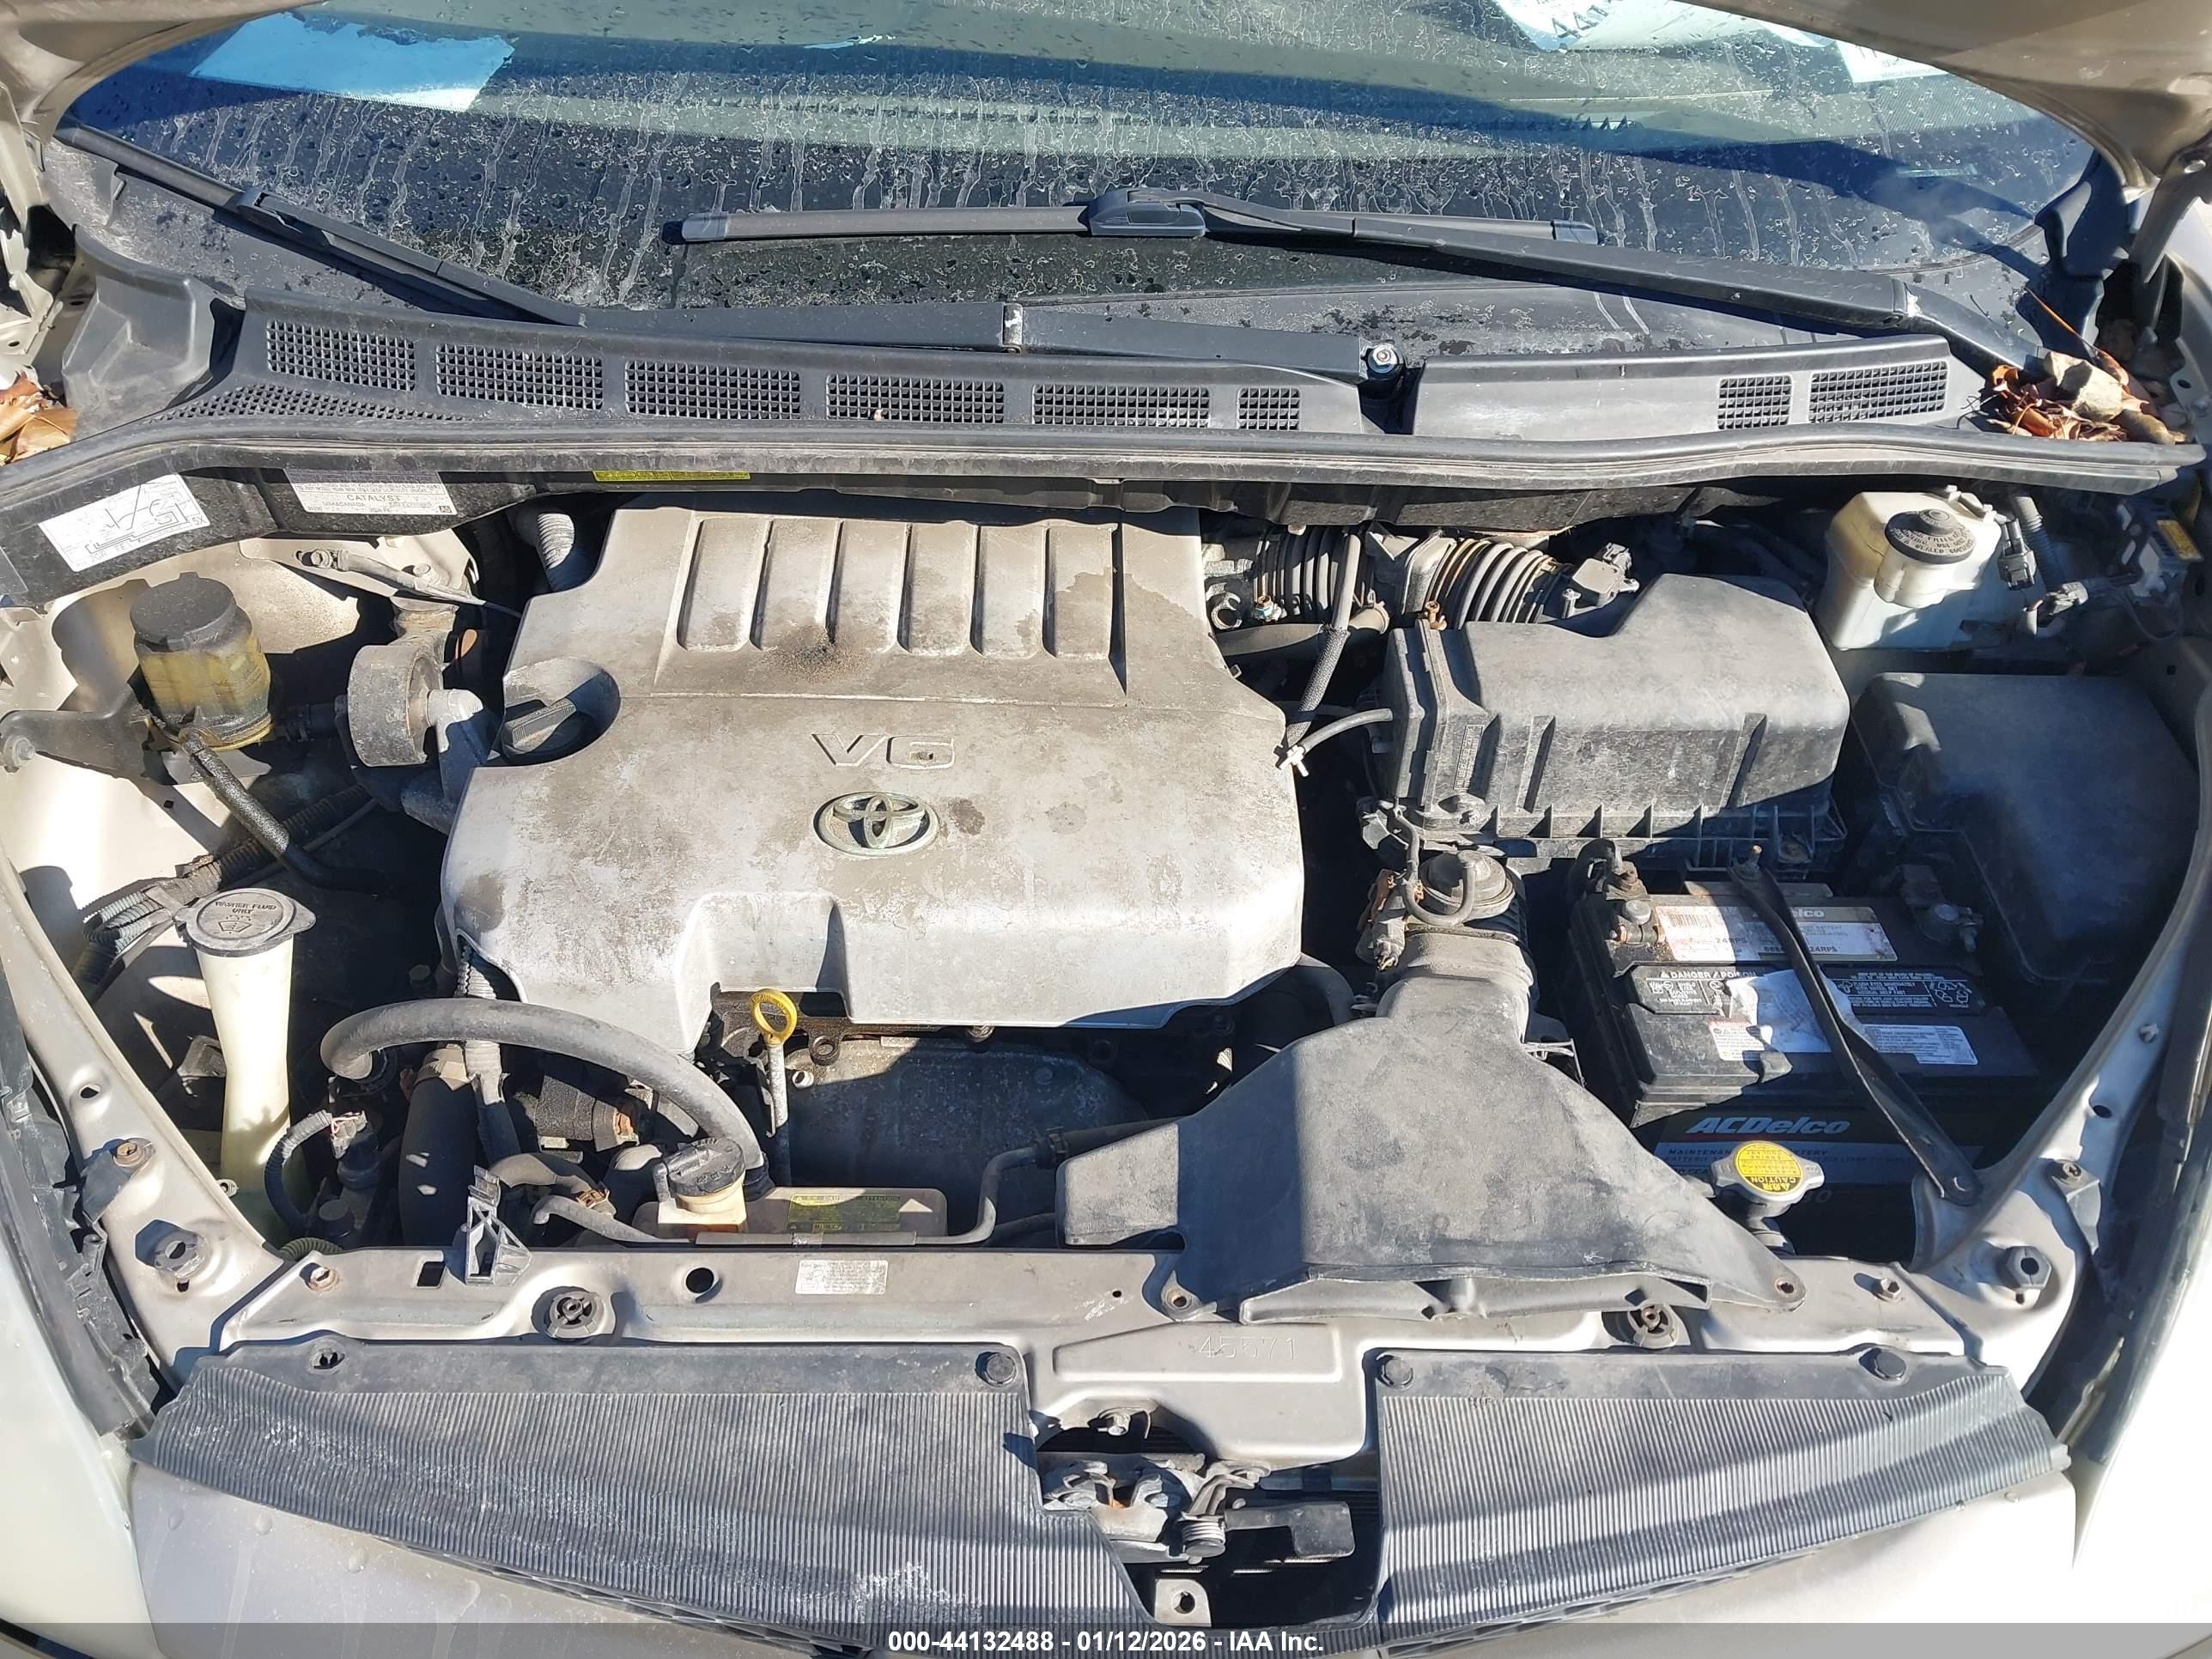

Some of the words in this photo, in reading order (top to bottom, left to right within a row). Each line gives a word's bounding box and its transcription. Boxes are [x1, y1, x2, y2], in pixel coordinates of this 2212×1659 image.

[346, 493, 402, 502] CATALYST
[811, 732, 956, 770] V6
[1686, 1116, 1851, 1134] ACDelco
[1198, 1334, 1297, 1360] 45571
